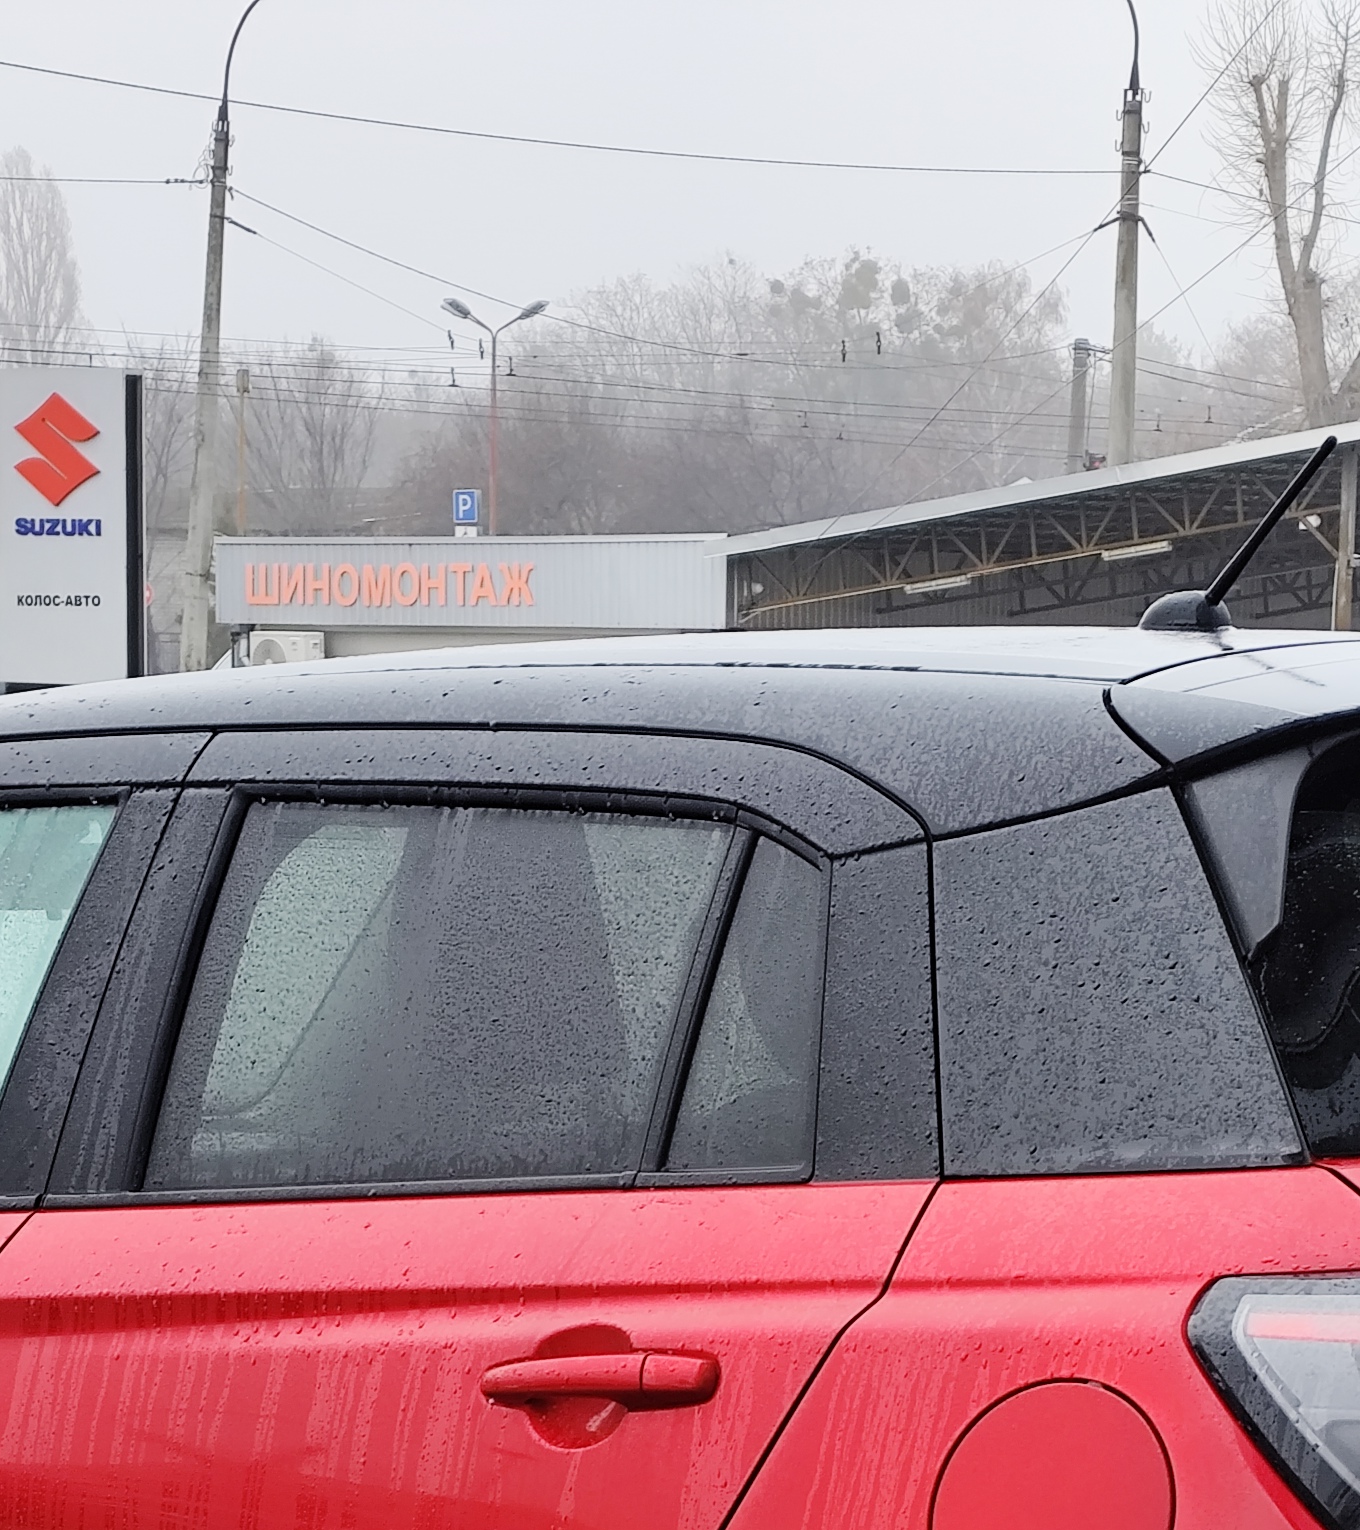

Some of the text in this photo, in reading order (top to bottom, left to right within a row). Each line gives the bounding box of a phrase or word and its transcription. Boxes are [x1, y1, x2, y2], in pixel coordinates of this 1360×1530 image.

[14, 517, 102, 537] SUZUKI
[245, 561, 535, 608] ШИНОМОНТАЖ
[16, 594, 102, 607] КОЛОС-АВТО
